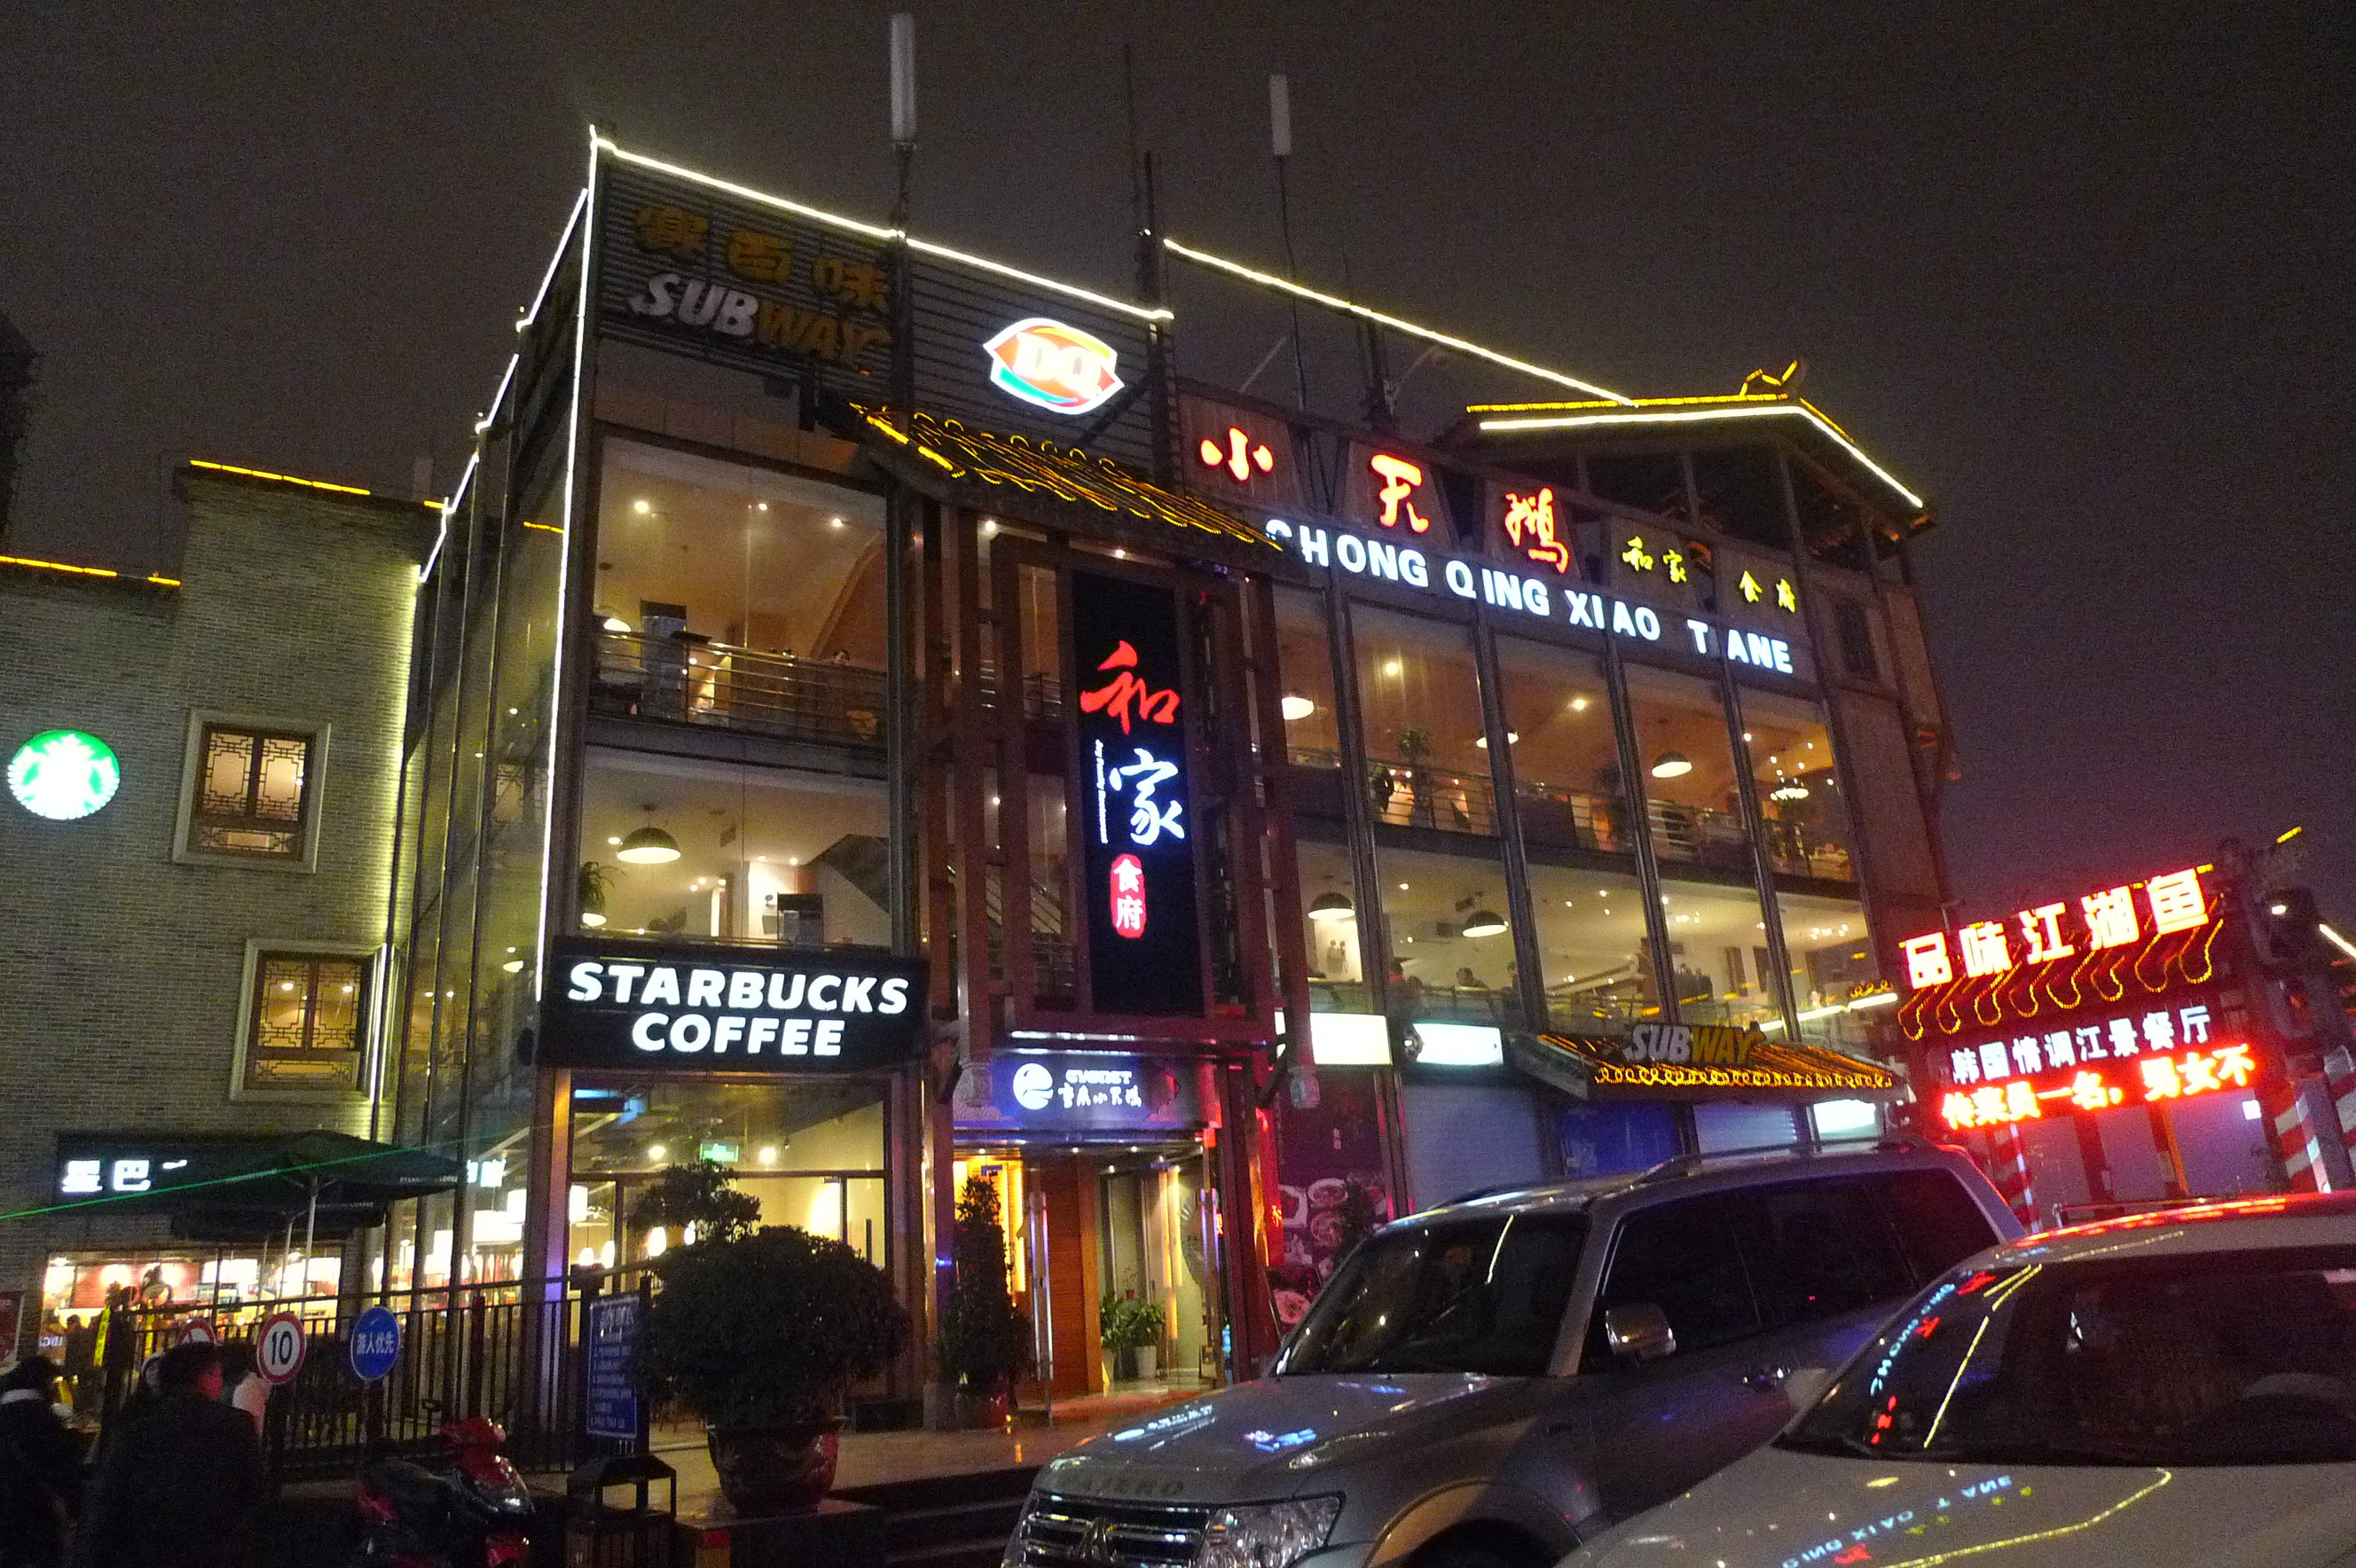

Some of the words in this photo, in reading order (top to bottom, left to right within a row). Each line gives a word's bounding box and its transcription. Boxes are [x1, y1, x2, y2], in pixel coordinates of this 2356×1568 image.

[627, 273, 892, 365] SUBWAY
[1012, 331, 1102, 399] DQ
[1447, 560, 1550, 616] QING
[1565, 589, 1661, 641] XIAO
[1113, 857, 1143, 930] 食府
[1904, 867, 2210, 990] 品味江湖鱼
[568, 961, 909, 1015] STARBUCKS
[632, 1012, 845, 1056] COFFEE
[1623, 1023, 1765, 1063] SUBWAY
[1951, 1005, 2211, 1085] 韩国情调江景餐厅
[271, 1330, 294, 1366] 10
